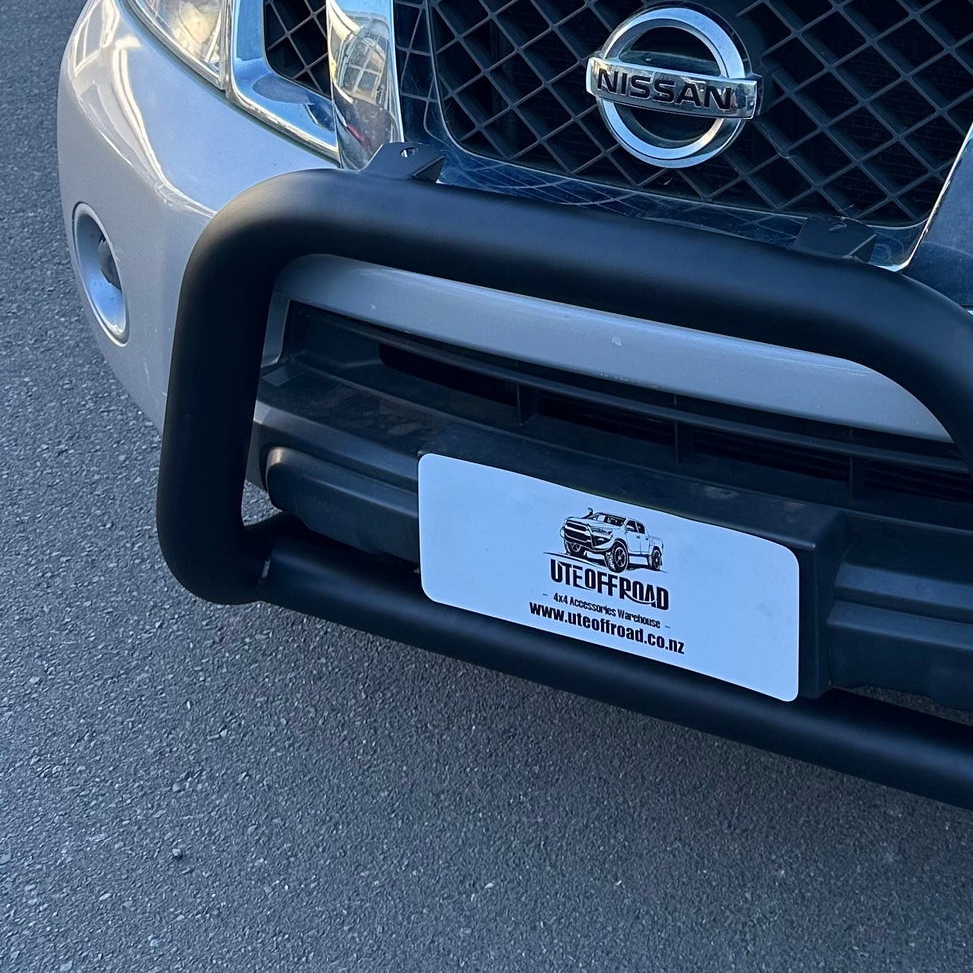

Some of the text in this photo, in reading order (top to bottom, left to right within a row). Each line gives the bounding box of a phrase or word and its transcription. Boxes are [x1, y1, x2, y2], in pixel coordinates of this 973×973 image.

[597, 68, 732, 111] NISSAN
[529, 601, 685, 655] www.uteoffroad.co.nz
[553, 592, 661, 629] 4x4 Accessories Warehouse
